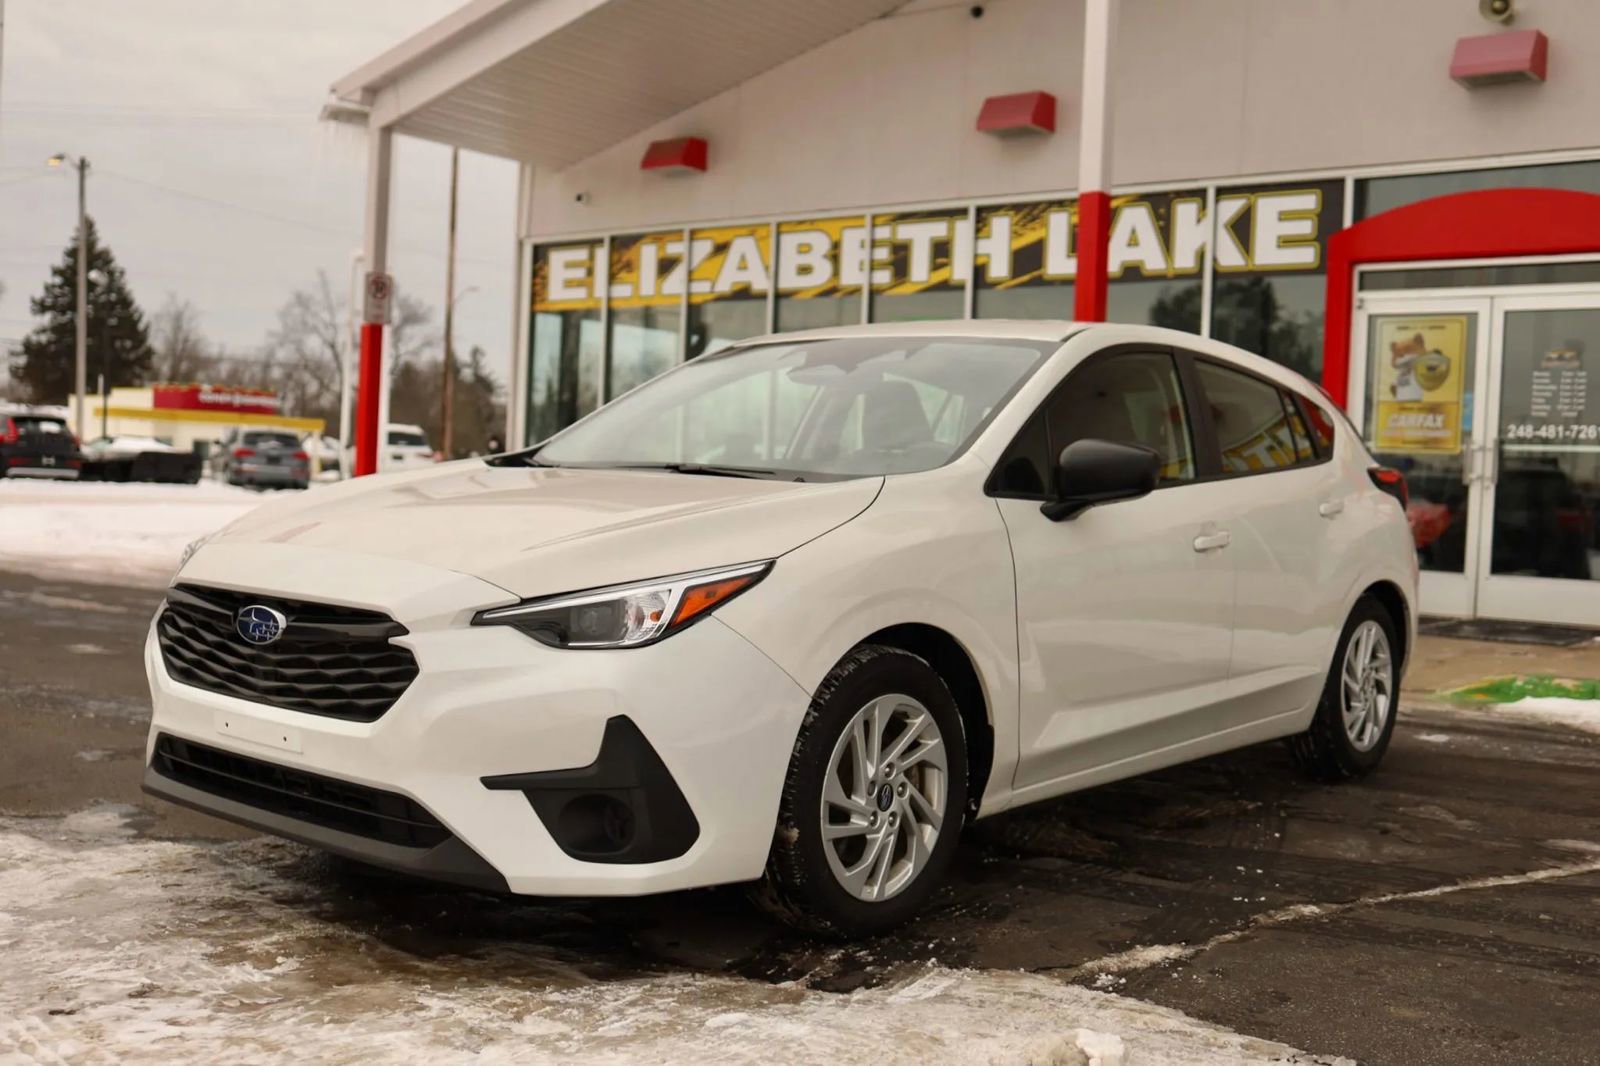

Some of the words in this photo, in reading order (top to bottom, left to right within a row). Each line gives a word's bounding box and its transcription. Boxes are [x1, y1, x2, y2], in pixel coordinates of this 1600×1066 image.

[546, 213, 1013, 301] ELIZABETH
[1044, 190, 1321, 279] LAKE
[1506, 424, 1600, 439] 248-481-726
